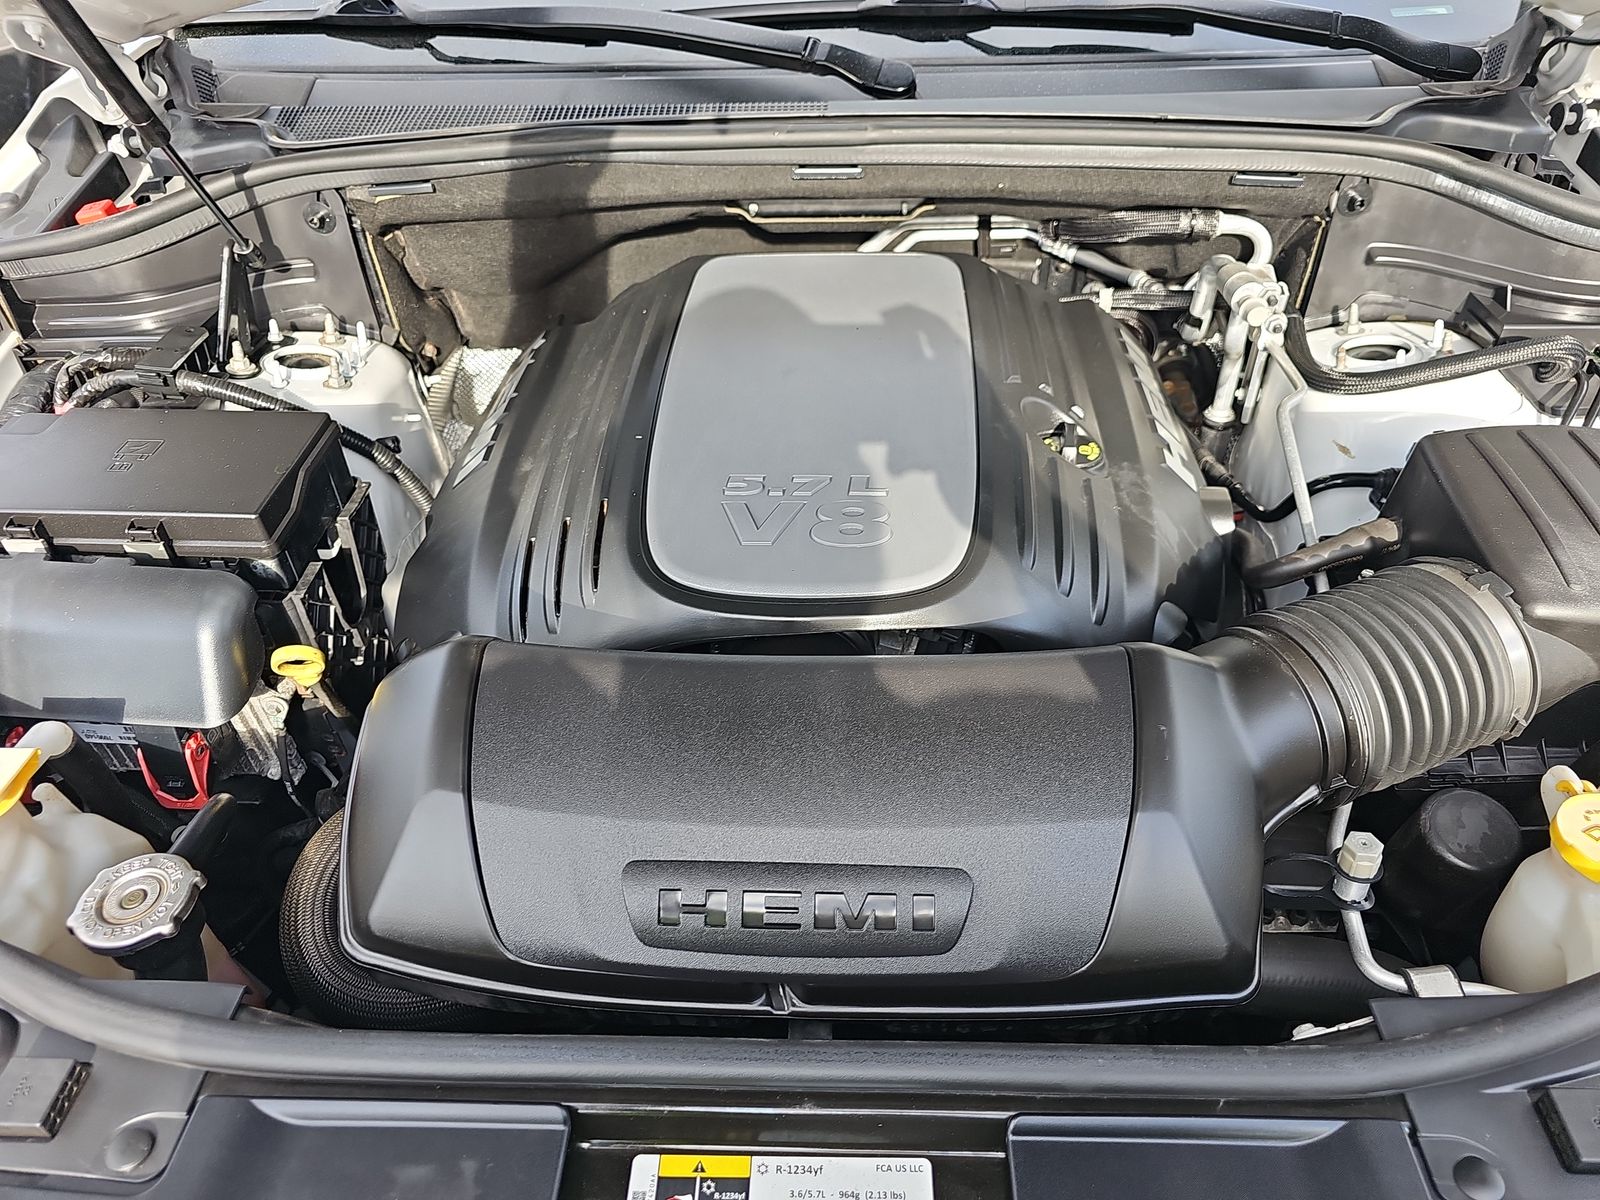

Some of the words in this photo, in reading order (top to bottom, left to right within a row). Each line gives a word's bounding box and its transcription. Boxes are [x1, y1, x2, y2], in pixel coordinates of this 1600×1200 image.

[722, 473, 833, 497] 5.7
[848, 474, 890, 497] L
[720, 500, 894, 548] V8
[111, 858, 152, 880] KEEP
[157, 857, 185, 880] TIGHT
[103, 922, 144, 938] OPEN
[147, 899, 174, 925] HOT
[657, 887, 937, 932] HEMI
[775, 1164, 824, 1177] R-1234yf
[875, 1164, 893, 1173] FCA
[894, 1164, 907, 1173] US
[909, 1164, 924, 1173] LLC
[647, 1173, 657, 1200] 420AA
[713, 1192, 746, 1200] R-1234yf
[789, 1189, 826, 1199] 3.6/5.7L
[838, 1190, 860, 1200] 964g
[865, 1190, 887, 1200] (2.13
[890, 1190, 906, 1200] lbs)
